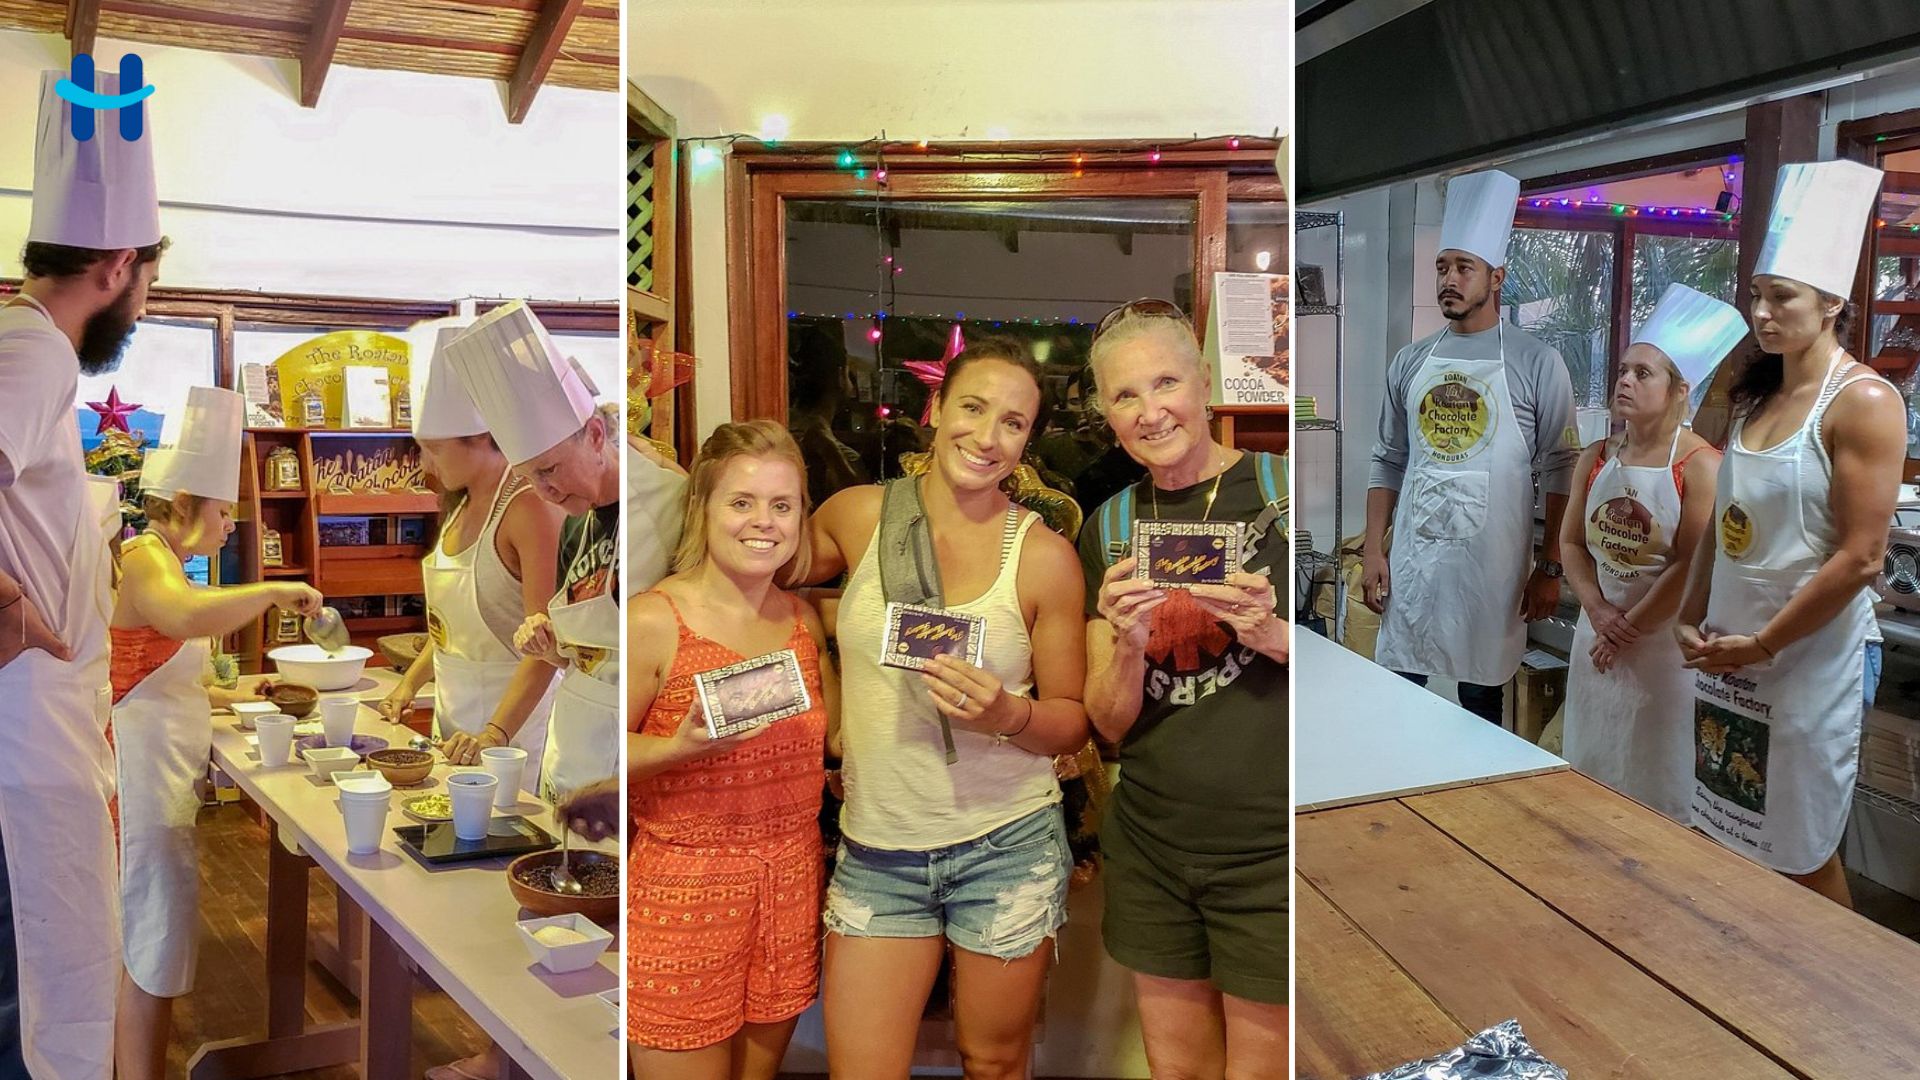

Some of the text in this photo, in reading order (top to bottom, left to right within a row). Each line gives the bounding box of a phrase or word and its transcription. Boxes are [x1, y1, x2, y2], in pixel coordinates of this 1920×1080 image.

[305, 344, 409, 366] The Roatan
[293, 368, 345, 398] Chocol
[1224, 377, 1265, 391] COCOA
[1236, 390, 1286, 403] POWDER
[1428, 409, 1477, 422] Chocolate
[1434, 423, 1470, 437] Factory
[1432, 450, 1469, 461] HONDURAS
[1598, 520, 1649, 544] Chocolate
[1601, 536, 1639, 556] Factory
[1601, 561, 1640, 578] HONDURAS
[1695, 673, 1731, 702] hocolate
